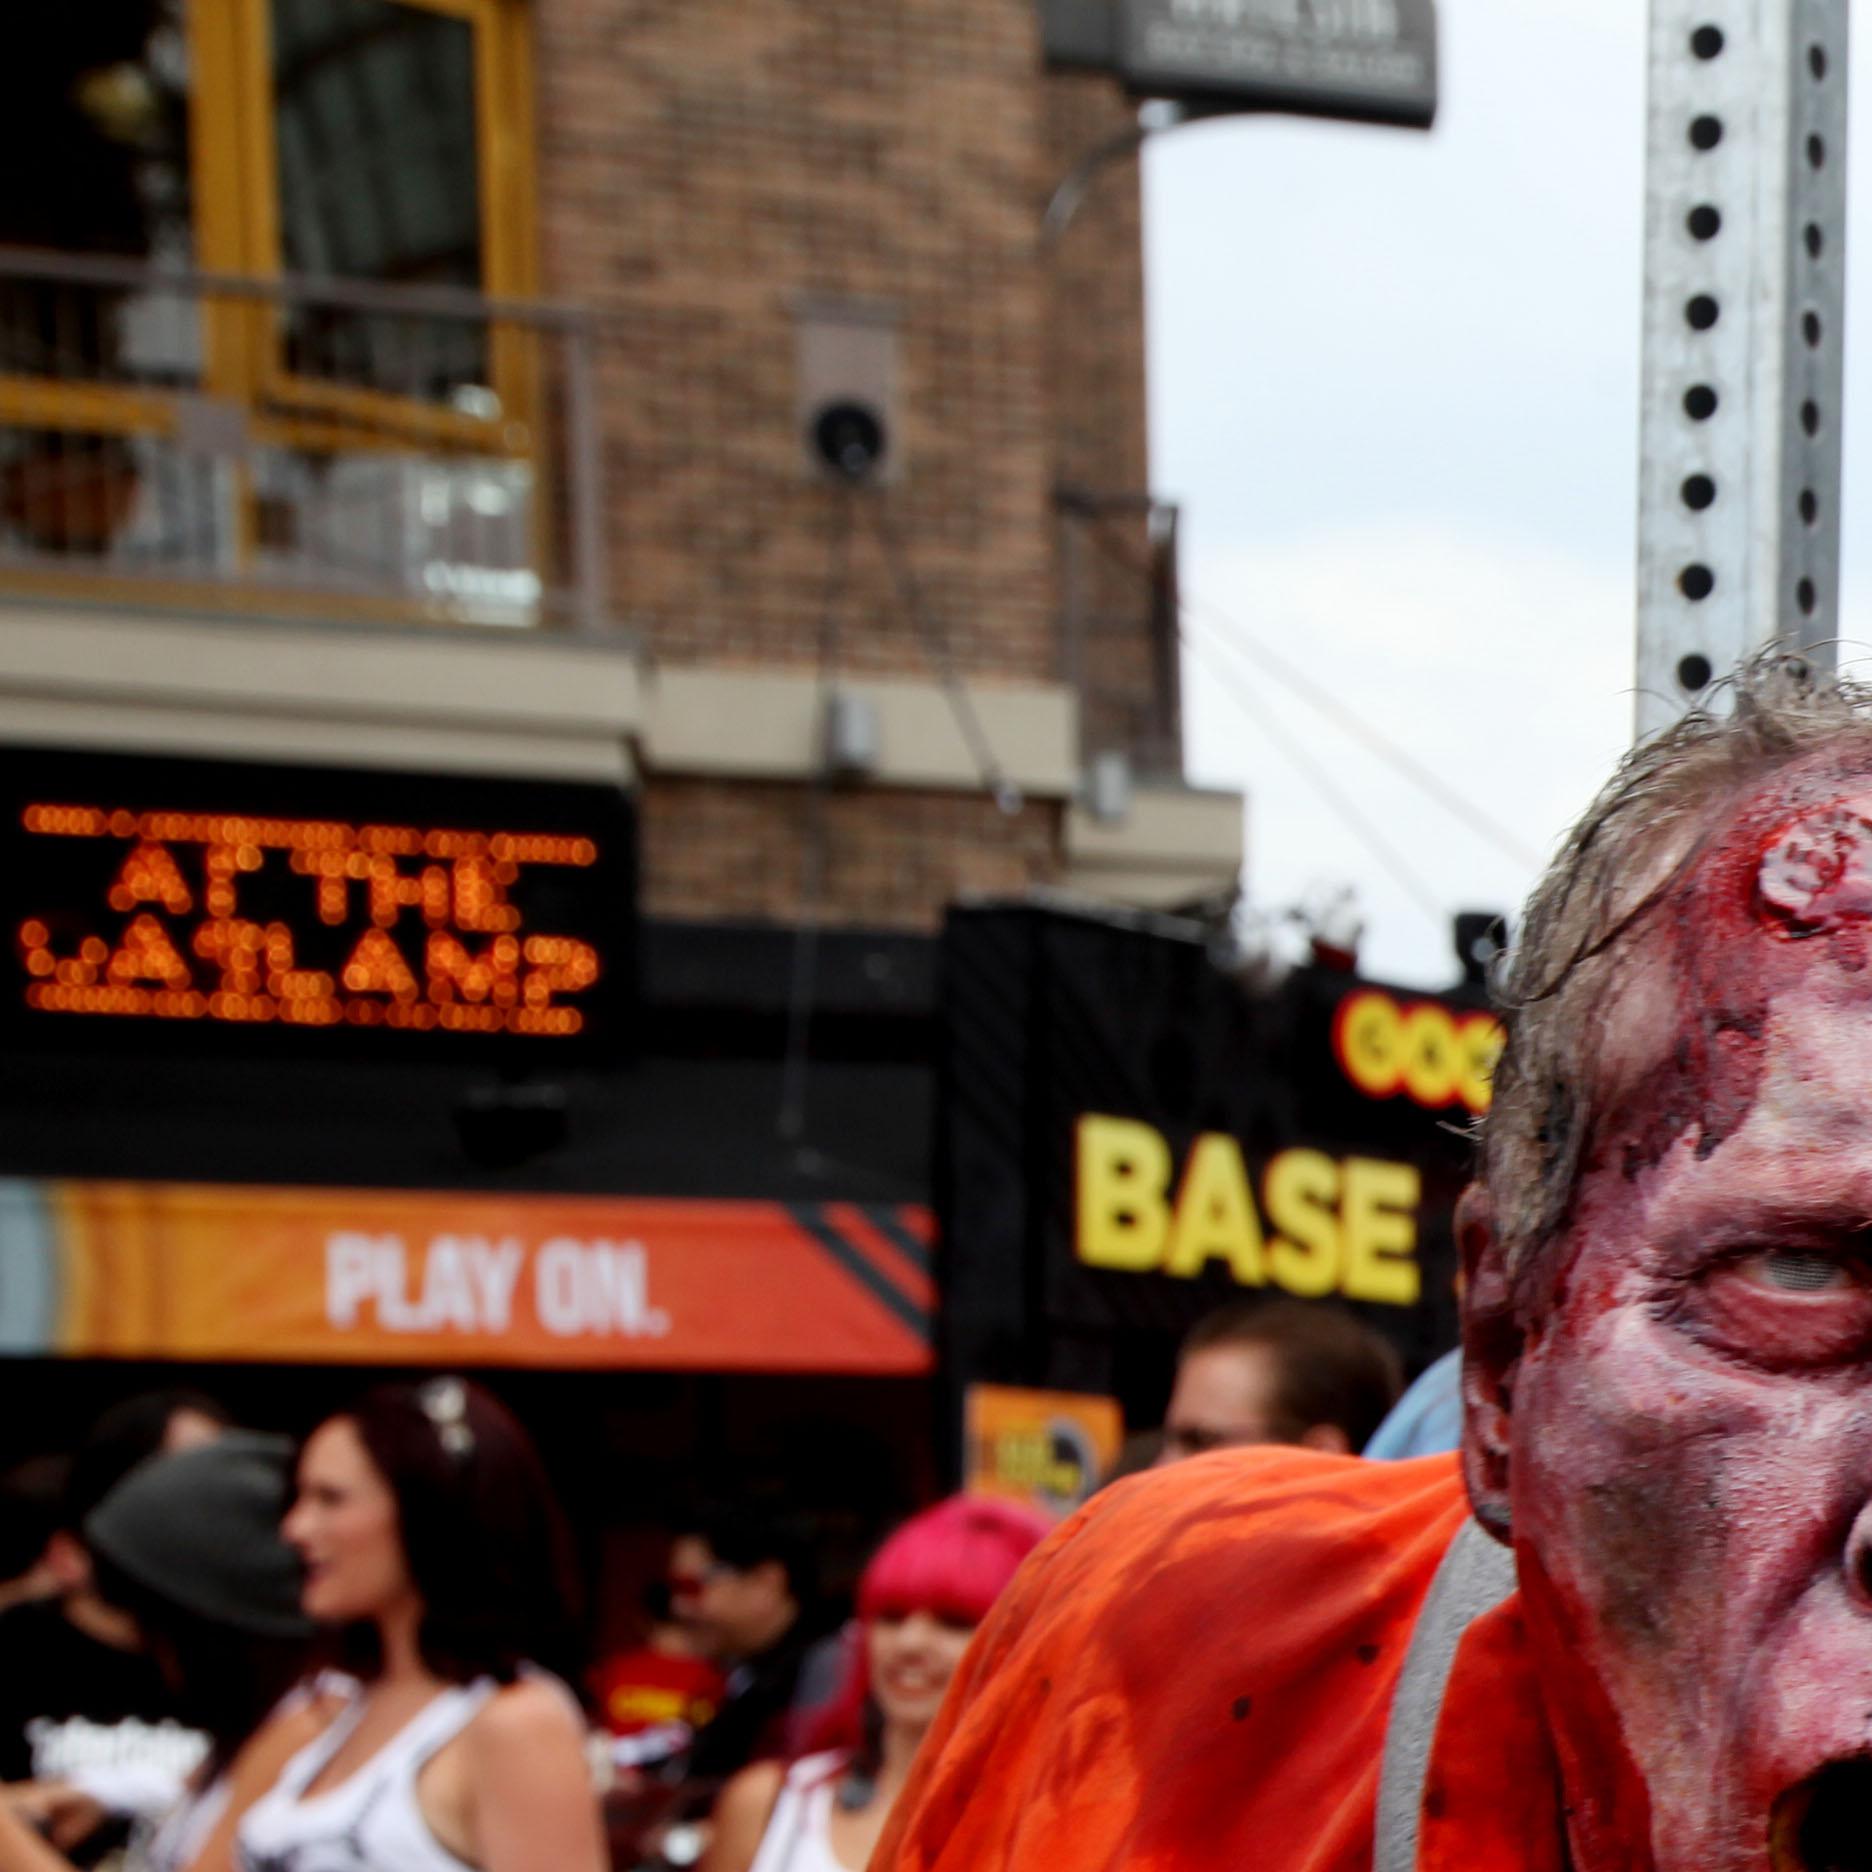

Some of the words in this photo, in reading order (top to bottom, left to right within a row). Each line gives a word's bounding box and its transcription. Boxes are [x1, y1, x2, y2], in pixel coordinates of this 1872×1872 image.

[293, 853, 521, 931] THE
[1075, 1112, 1421, 1306] BASE
[326, 1233, 523, 1331] PLAY
[535, 1239, 670, 1338] ON.
